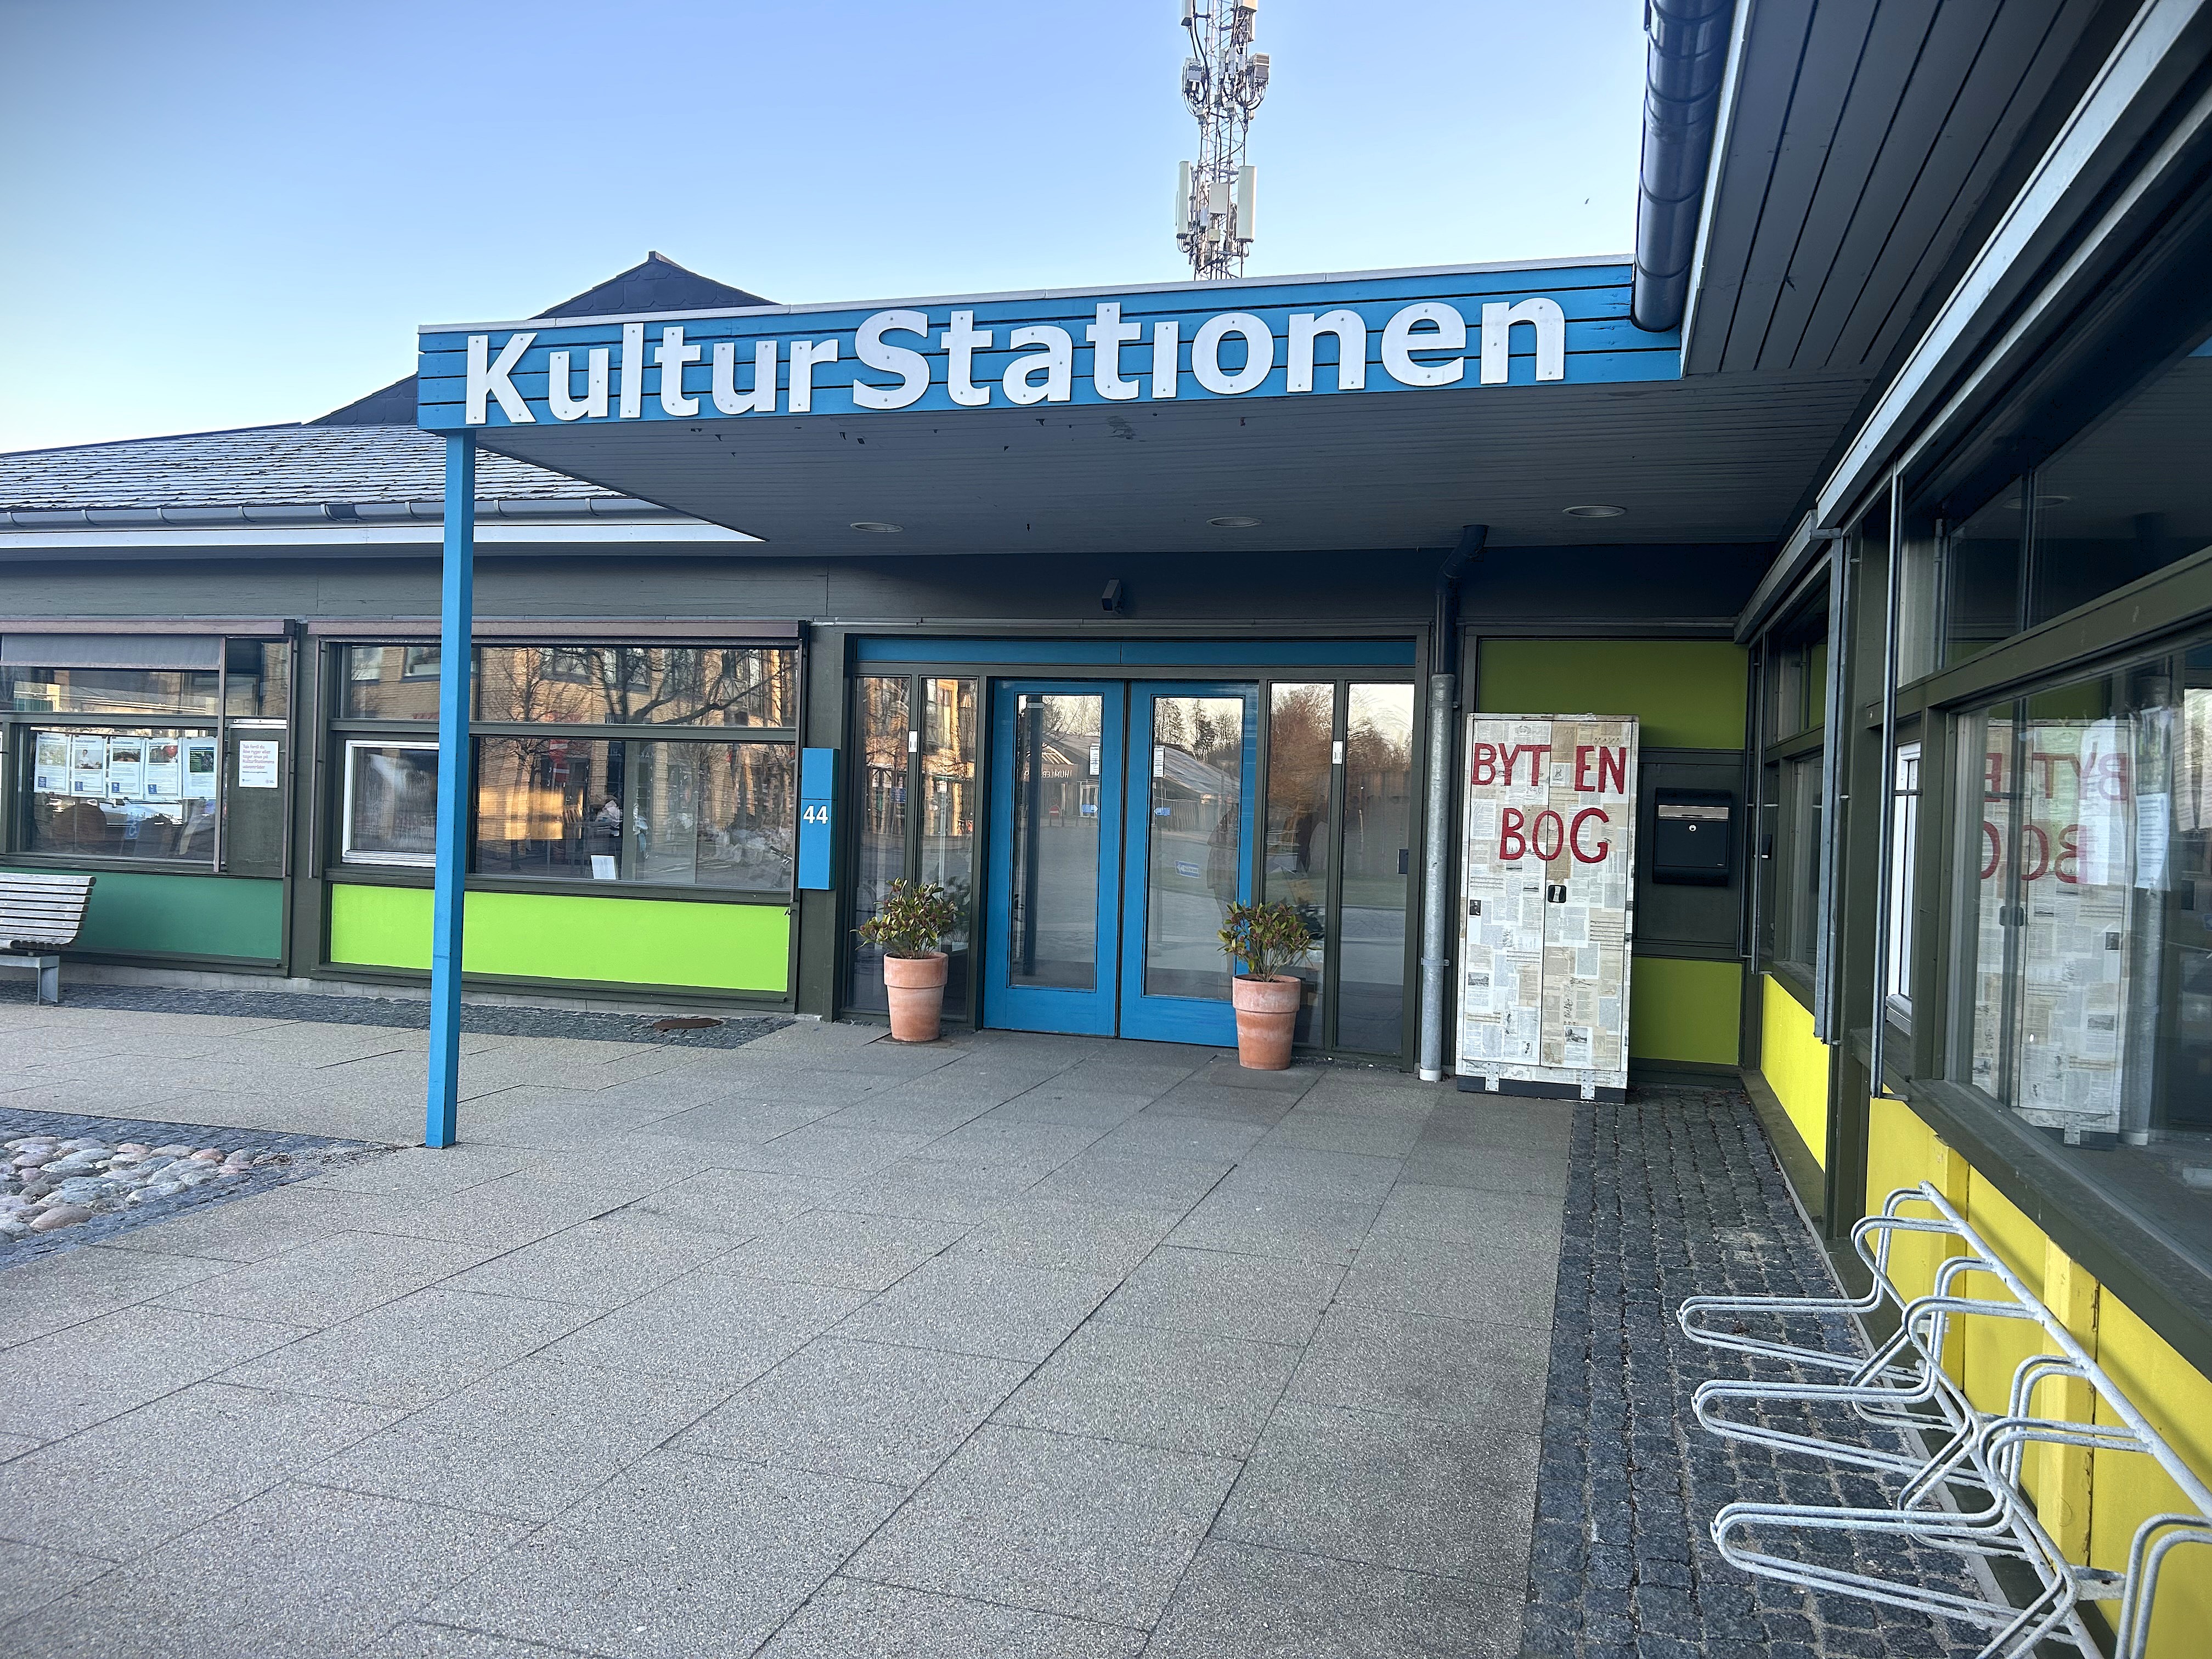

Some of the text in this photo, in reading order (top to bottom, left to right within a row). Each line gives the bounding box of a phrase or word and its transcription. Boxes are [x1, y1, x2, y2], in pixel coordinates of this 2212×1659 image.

[465, 297, 1565, 425] KulturStationen
[1471, 742, 1627, 795] BYT EN
[803, 805, 828, 825] 44
[1499, 807, 1610, 864] BOG
